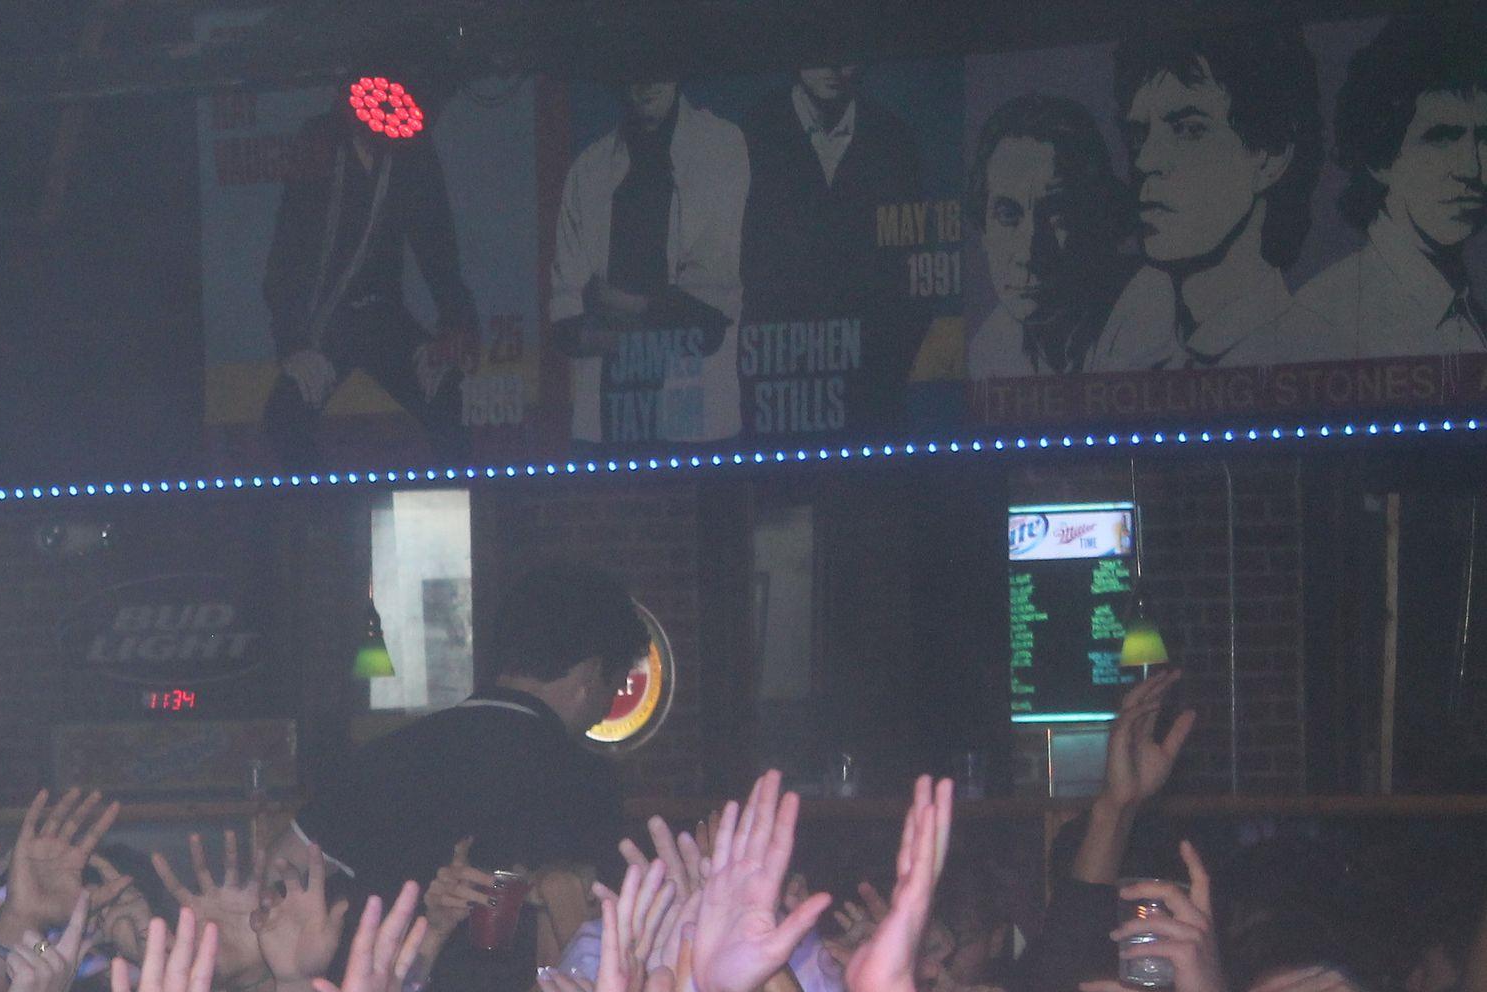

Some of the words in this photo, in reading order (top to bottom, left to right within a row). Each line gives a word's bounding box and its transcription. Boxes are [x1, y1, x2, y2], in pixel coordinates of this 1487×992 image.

[876, 201, 929, 247] MAY
[907, 251, 961, 298] 1991
[611, 326, 704, 384] JAMES
[741, 318, 862, 377] STEPHEN
[754, 378, 845, 433] STILLS
[993, 378, 1065, 418] THE
[1086, 371, 1253, 413] ROLLING
[1273, 362, 1438, 405] STONES
[113, 604, 236, 631] BUD
[86, 634, 264, 661] LIGHT
